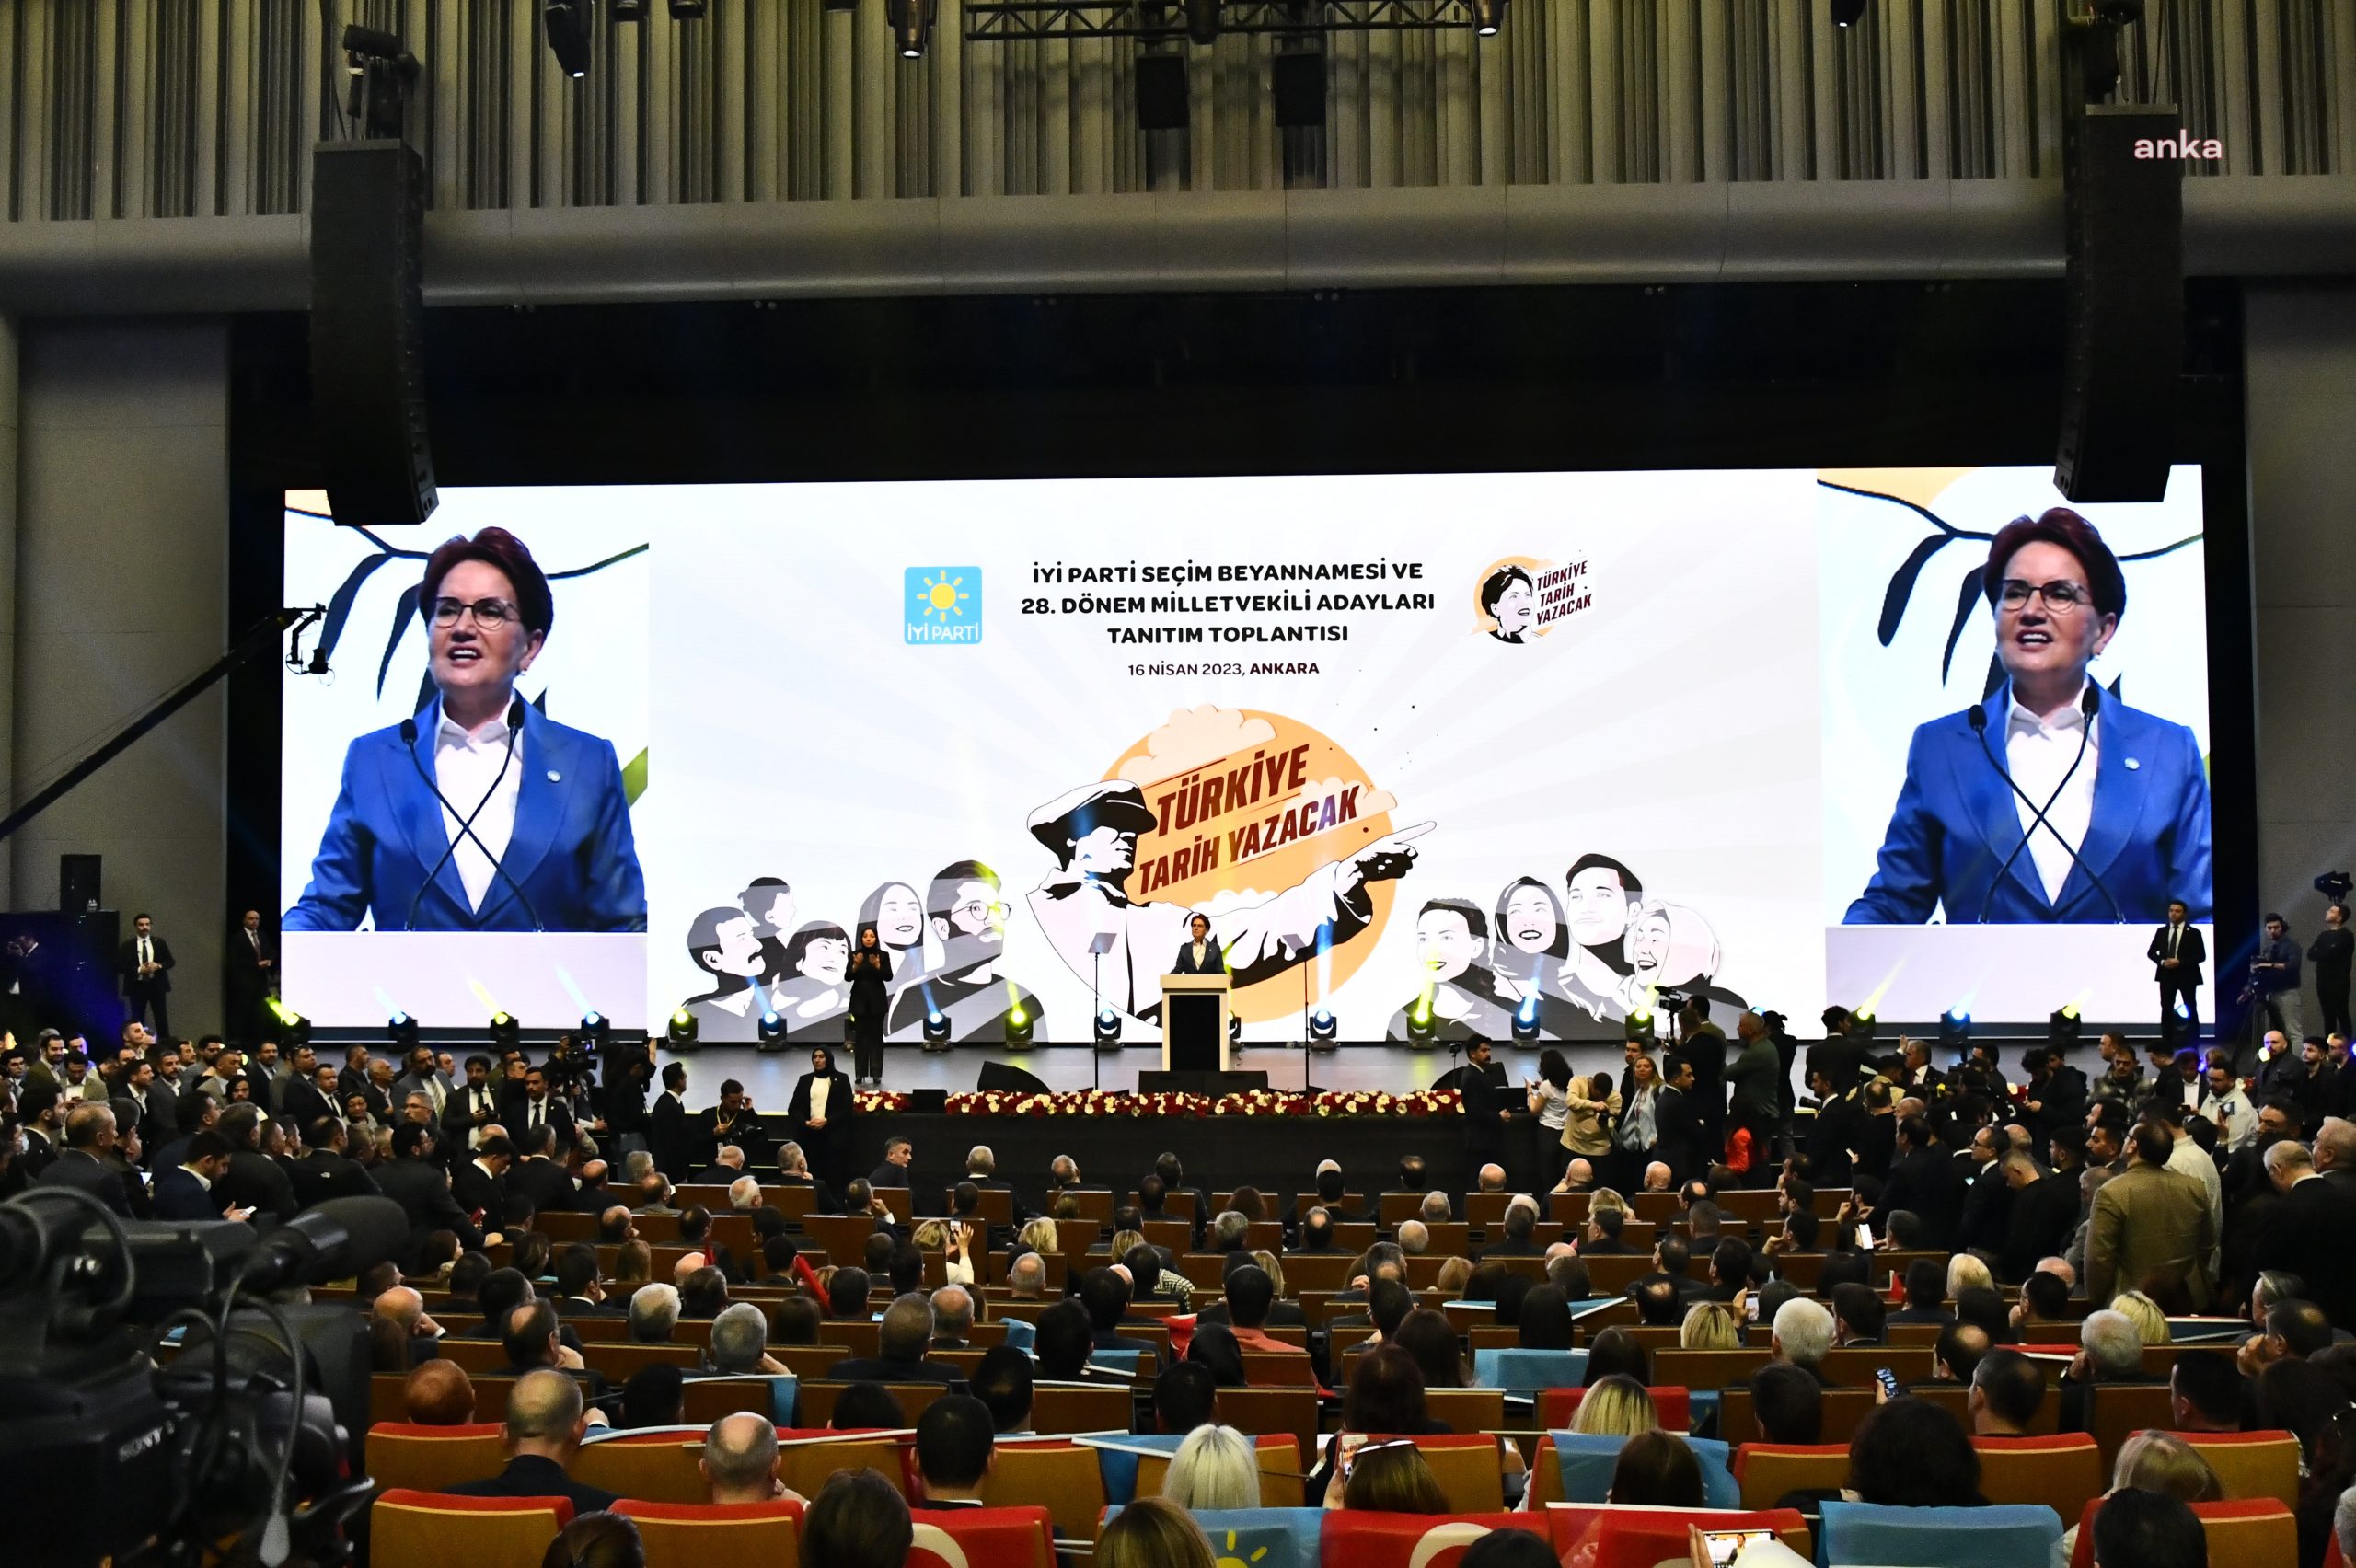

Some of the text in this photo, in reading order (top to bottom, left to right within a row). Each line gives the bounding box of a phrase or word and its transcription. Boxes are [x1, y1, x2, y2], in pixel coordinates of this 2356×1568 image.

[1033, 558, 1423, 587] İYİ PARTİ SEÇİM BEYANNAMESİ VE
[1536, 559, 1588, 587] TÜRKİYE
[1022, 590, 1435, 615] 28. DÖNEM MİLLETVEKİLİ ADAYLARI
[1540, 582, 1575, 607] TARİH
[1536, 593, 1592, 626] YAZACAK
[907, 622, 979, 641] İYİ PARTİ
[1106, 625, 1348, 644] TANITIM TOPLANTISI
[1127, 660, 1320, 677] 16 NİSAN 2023, ANKARA
[1157, 743, 1310, 837] TÜRKİYE
[1139, 785, 1360, 896] TARİH YAZACAK
